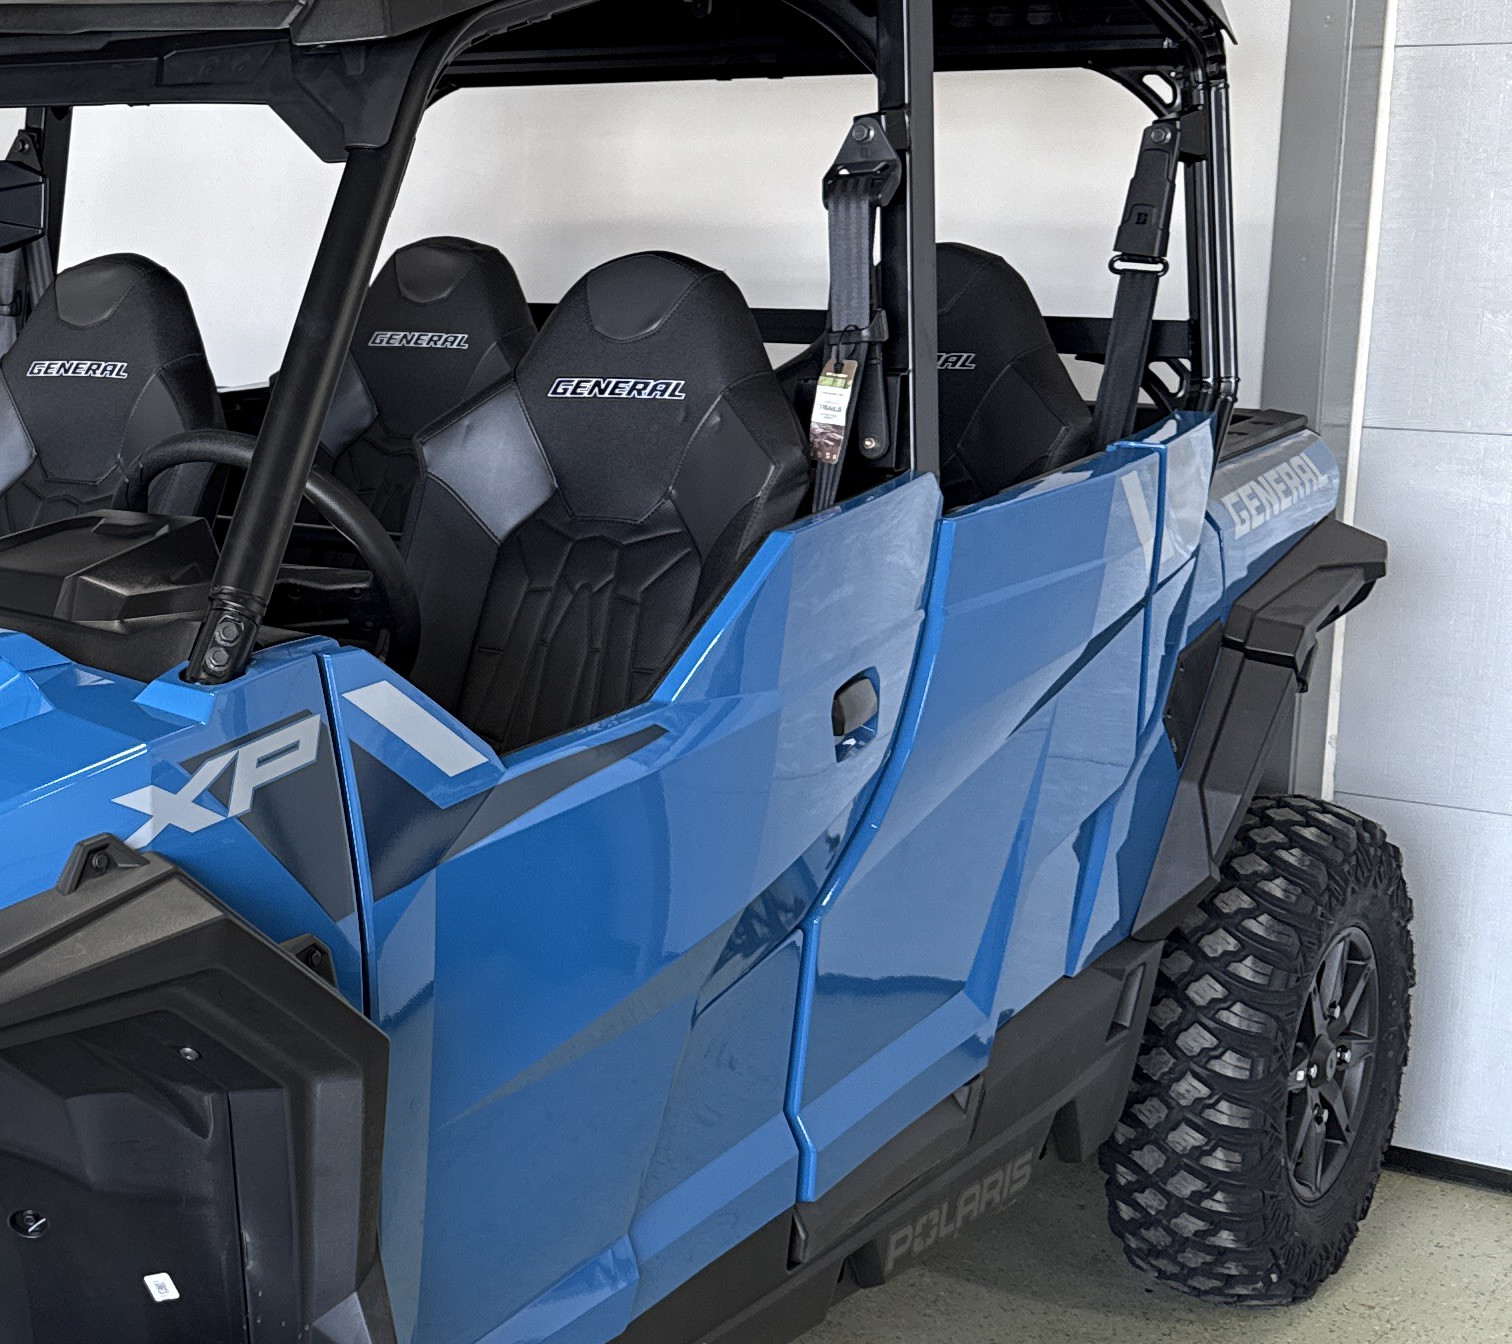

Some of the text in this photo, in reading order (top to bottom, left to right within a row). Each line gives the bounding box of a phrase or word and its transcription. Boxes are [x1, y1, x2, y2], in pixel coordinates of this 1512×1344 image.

[368, 331, 469, 349] GENERAL
[26, 360, 129, 379] GENERAL
[547, 378, 686, 400] GENERAL
[1220, 452, 1329, 540] GENERAL
[110, 713, 322, 850] XP
[883, 1146, 1034, 1278] POLARIS
